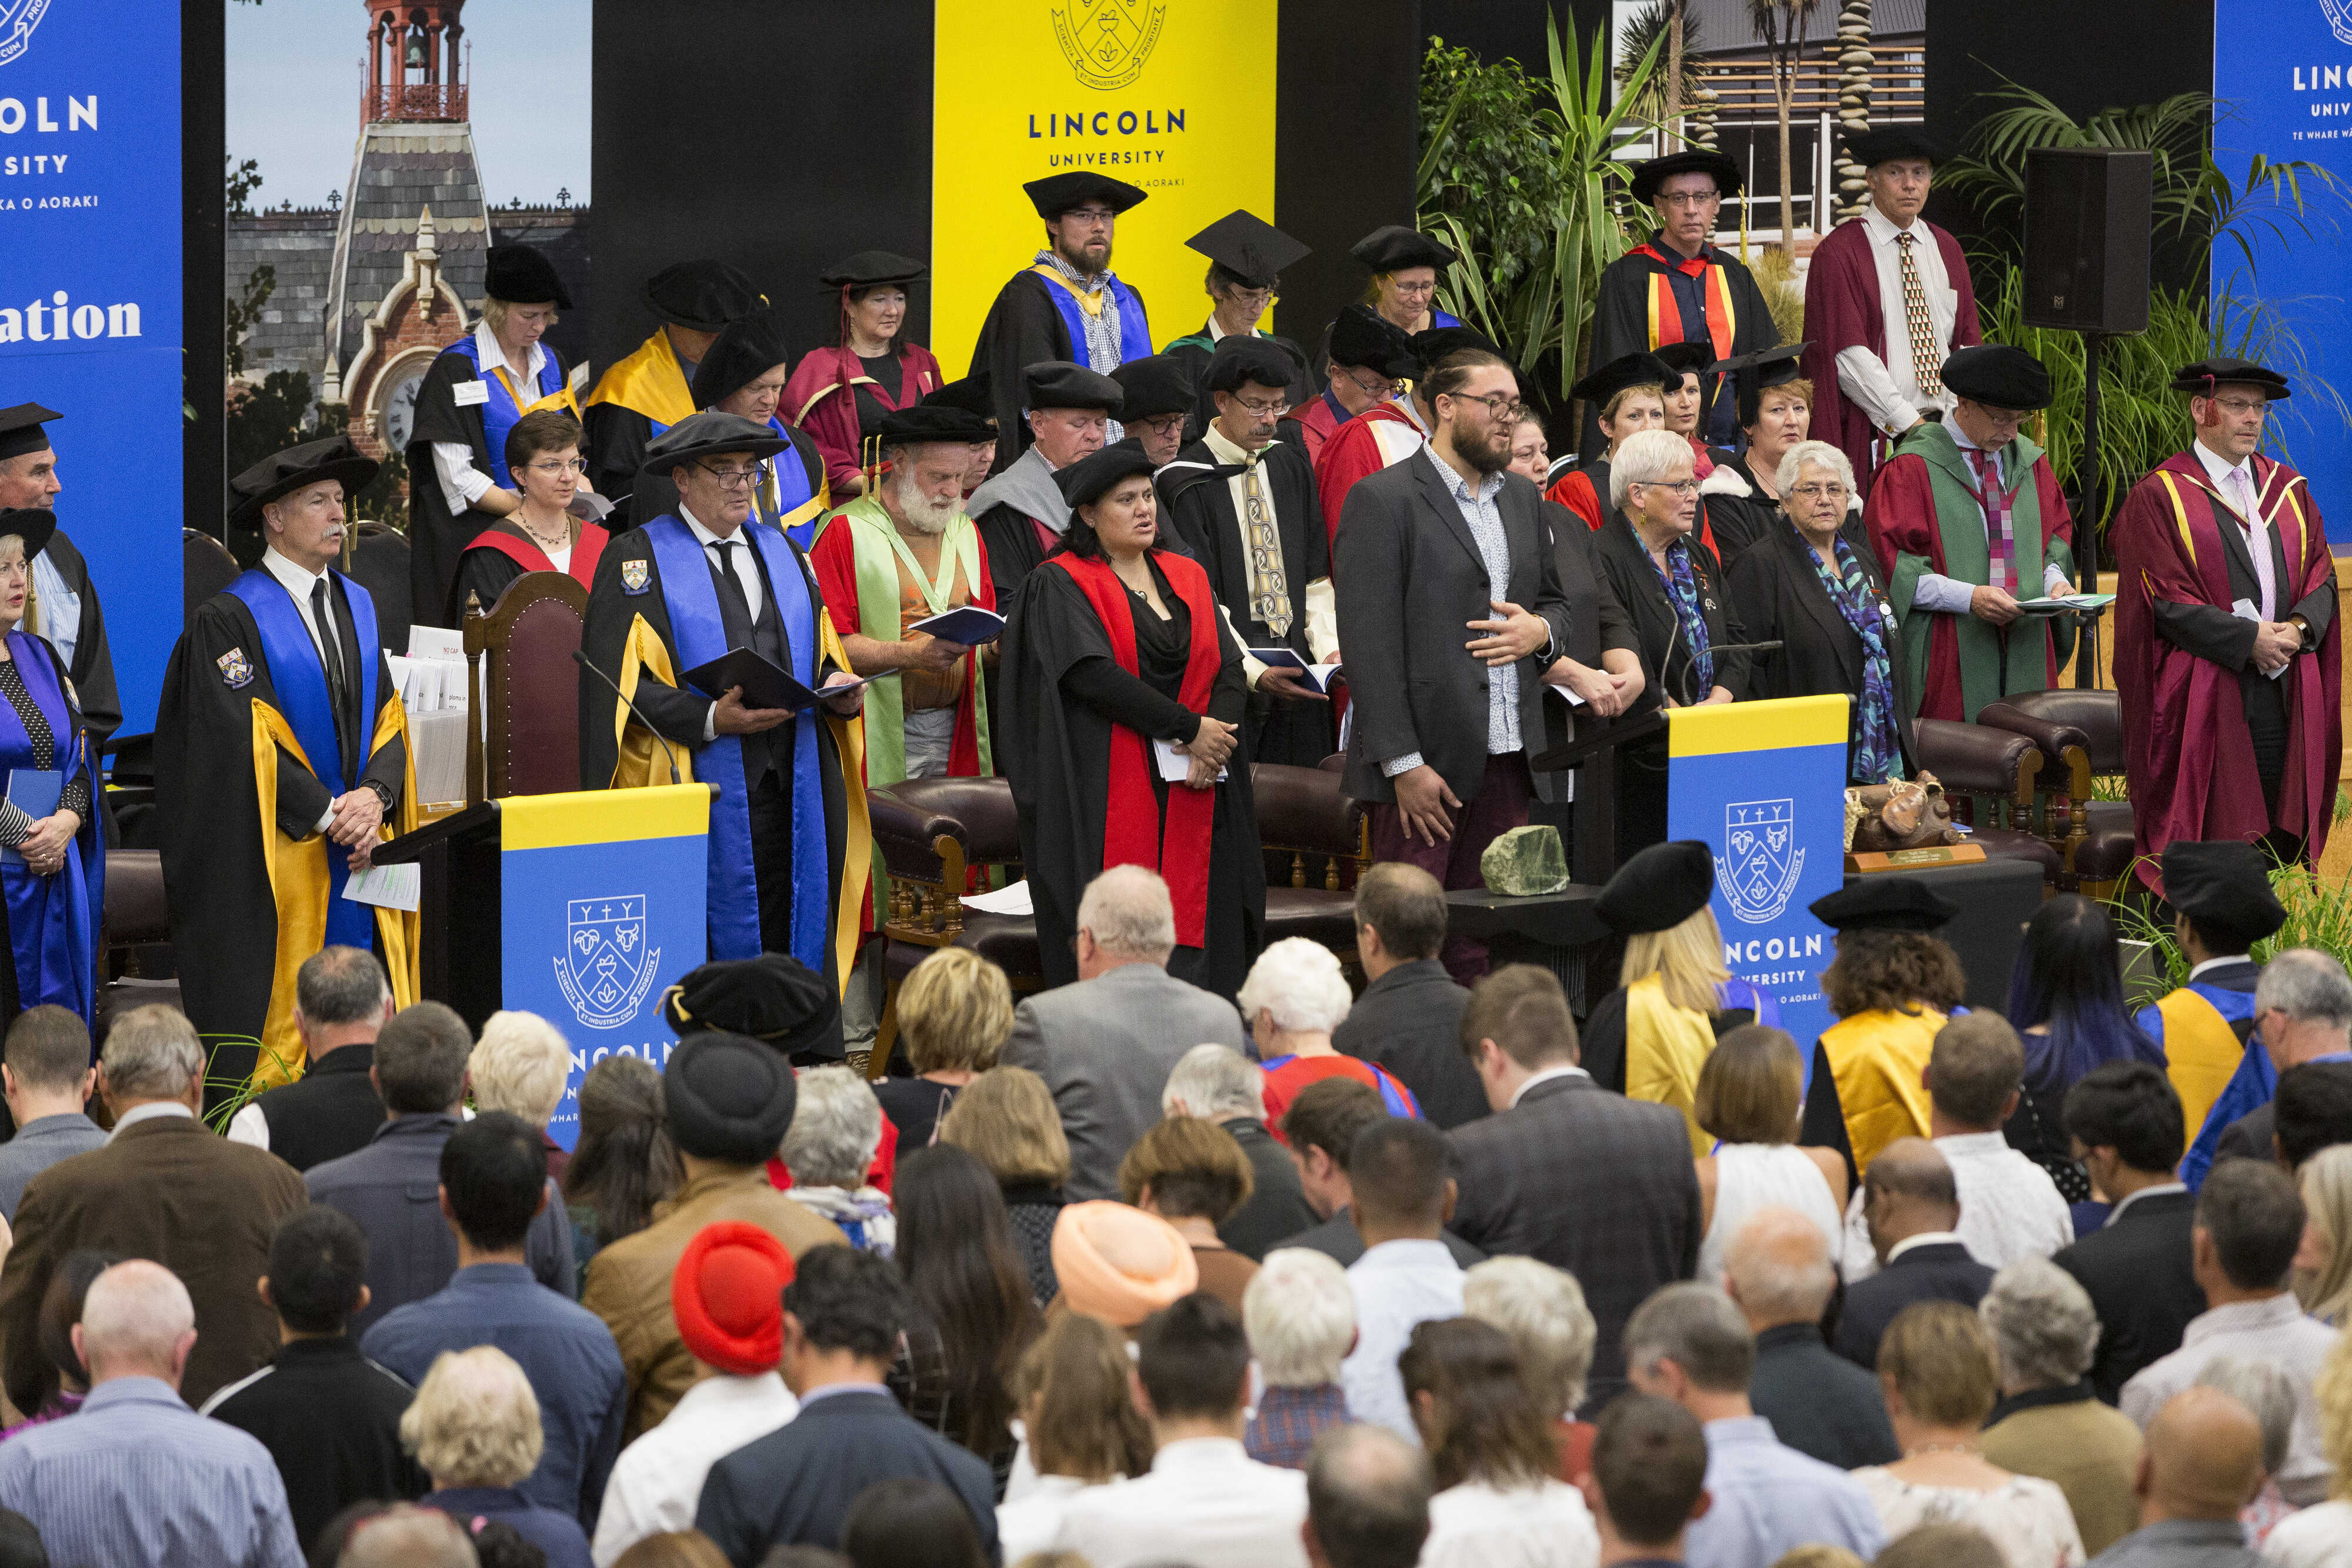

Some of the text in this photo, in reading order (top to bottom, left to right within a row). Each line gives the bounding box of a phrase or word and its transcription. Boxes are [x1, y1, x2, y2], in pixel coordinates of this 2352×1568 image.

[2311, 102, 2351, 117] UNIV
[1029, 109, 1185, 138] LINCOLN
[2293, 131, 2303, 141] TE
[2307, 129, 2338, 139] WHARE
[5, 154, 68, 175] SITY
[1050, 150, 1165, 166] UNIVERSITY
[1146, 178, 1185, 188] AORAKI
[21, 198, 33, 209] O
[38, 195, 98, 209] AORAKI
[0, 290, 142, 343] ation
[1725, 934, 1821, 965] NCOLN
[559, 970, 576, 1002] SCIENTIA
[637, 959, 655, 996] PROBITATE
[1780, 993, 1821, 1004] O AORAKI
